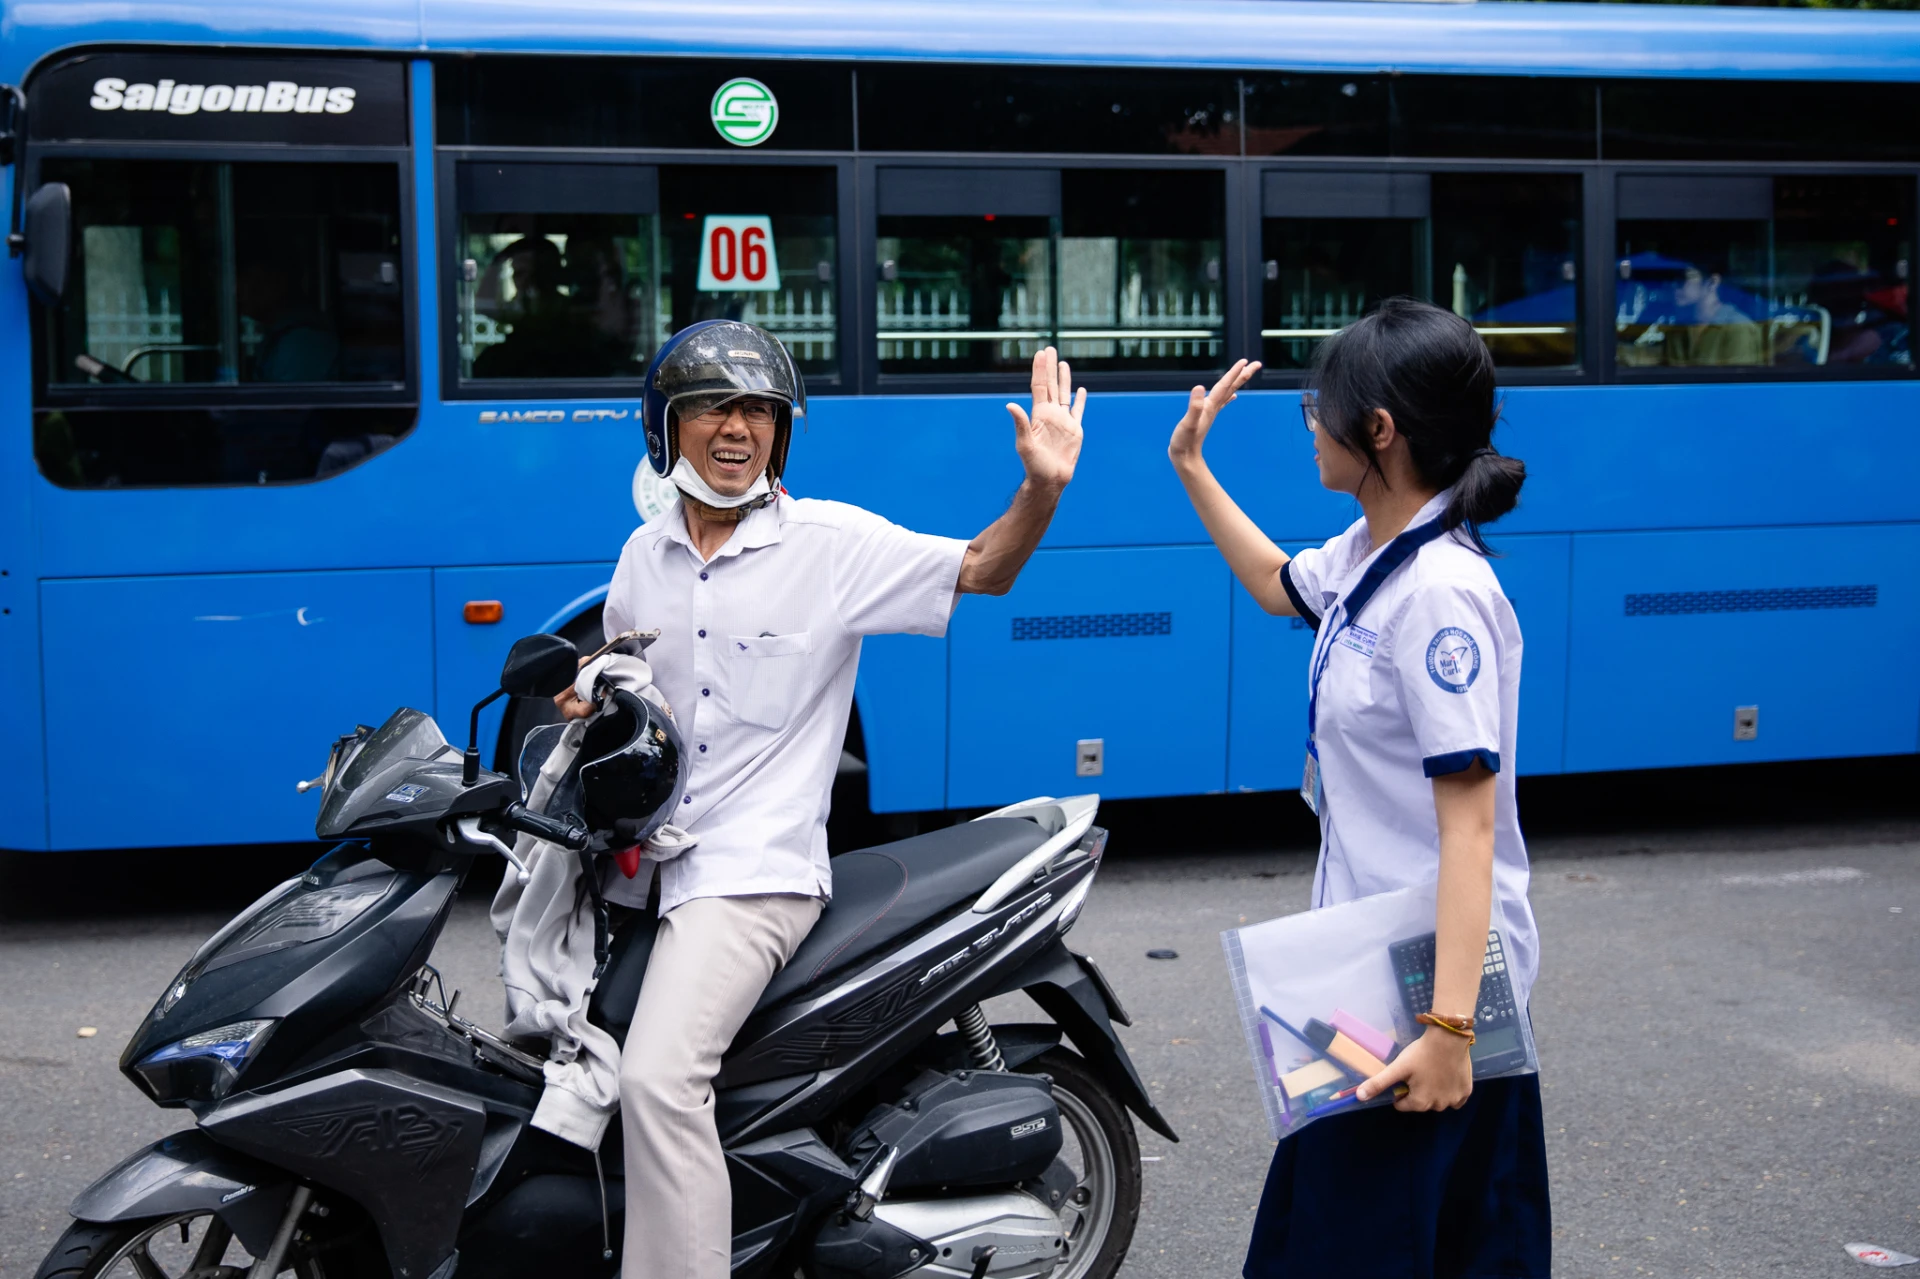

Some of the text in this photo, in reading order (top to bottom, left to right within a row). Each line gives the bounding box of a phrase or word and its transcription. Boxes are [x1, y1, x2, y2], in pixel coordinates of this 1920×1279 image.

[90, 77, 356, 115] SaigonBus
[711, 226, 767, 282] 06
[478, 410, 566, 424] SAMCO
[572, 409, 629, 423] CITY
